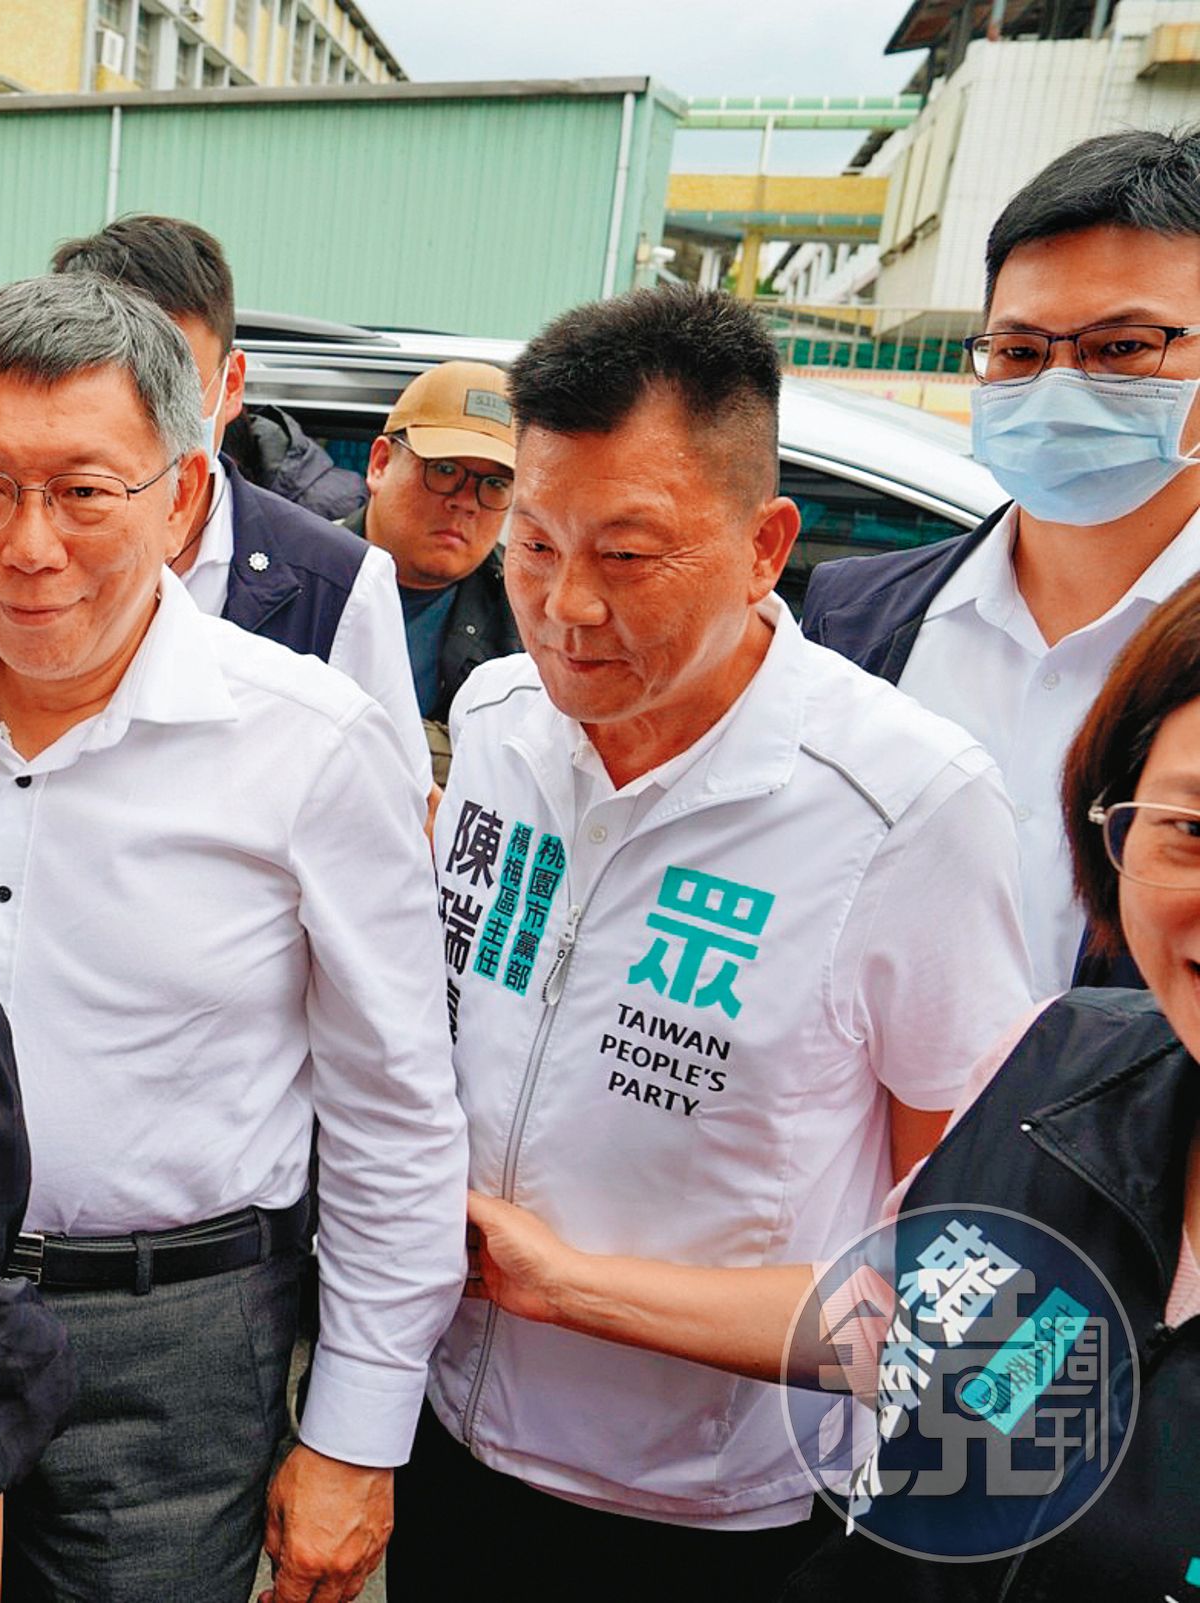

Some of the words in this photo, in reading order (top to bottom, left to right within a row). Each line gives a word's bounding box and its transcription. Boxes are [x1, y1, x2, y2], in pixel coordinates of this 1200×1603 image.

[476, 826, 532, 980] 楊梅區主任
[505, 836, 566, 992] 桃園市黨部
[617, 1002, 731, 1061] TAIWAN
[608, 1070, 700, 1117] PARTY
